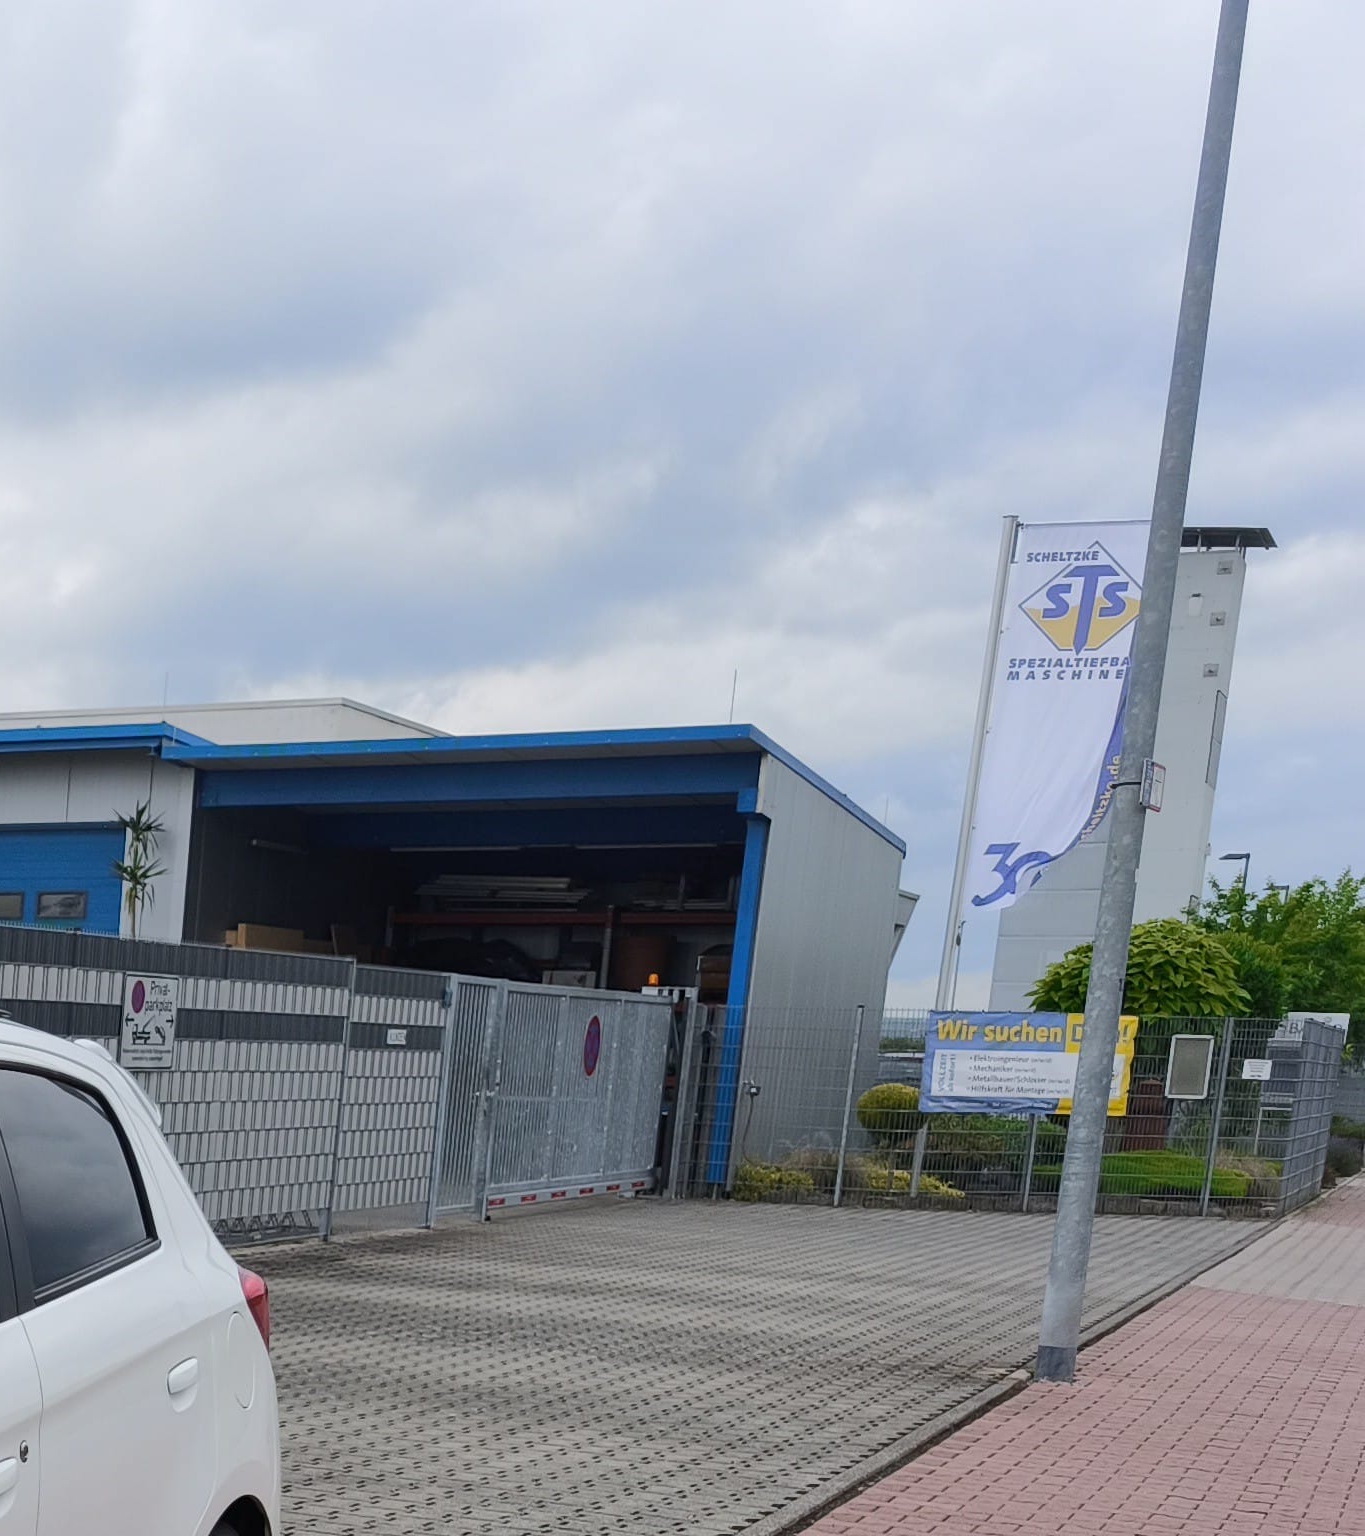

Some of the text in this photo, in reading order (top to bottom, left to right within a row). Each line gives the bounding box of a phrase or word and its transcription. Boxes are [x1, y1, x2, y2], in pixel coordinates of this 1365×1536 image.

[1026, 551, 1100, 562] SCHELTZKE
[1042, 564, 1130, 655] STS
[937, 1019, 978, 1042] Wir
[983, 1020, 1063, 1043] suchen
[972, 1064, 1014, 1072] Mechaniker
